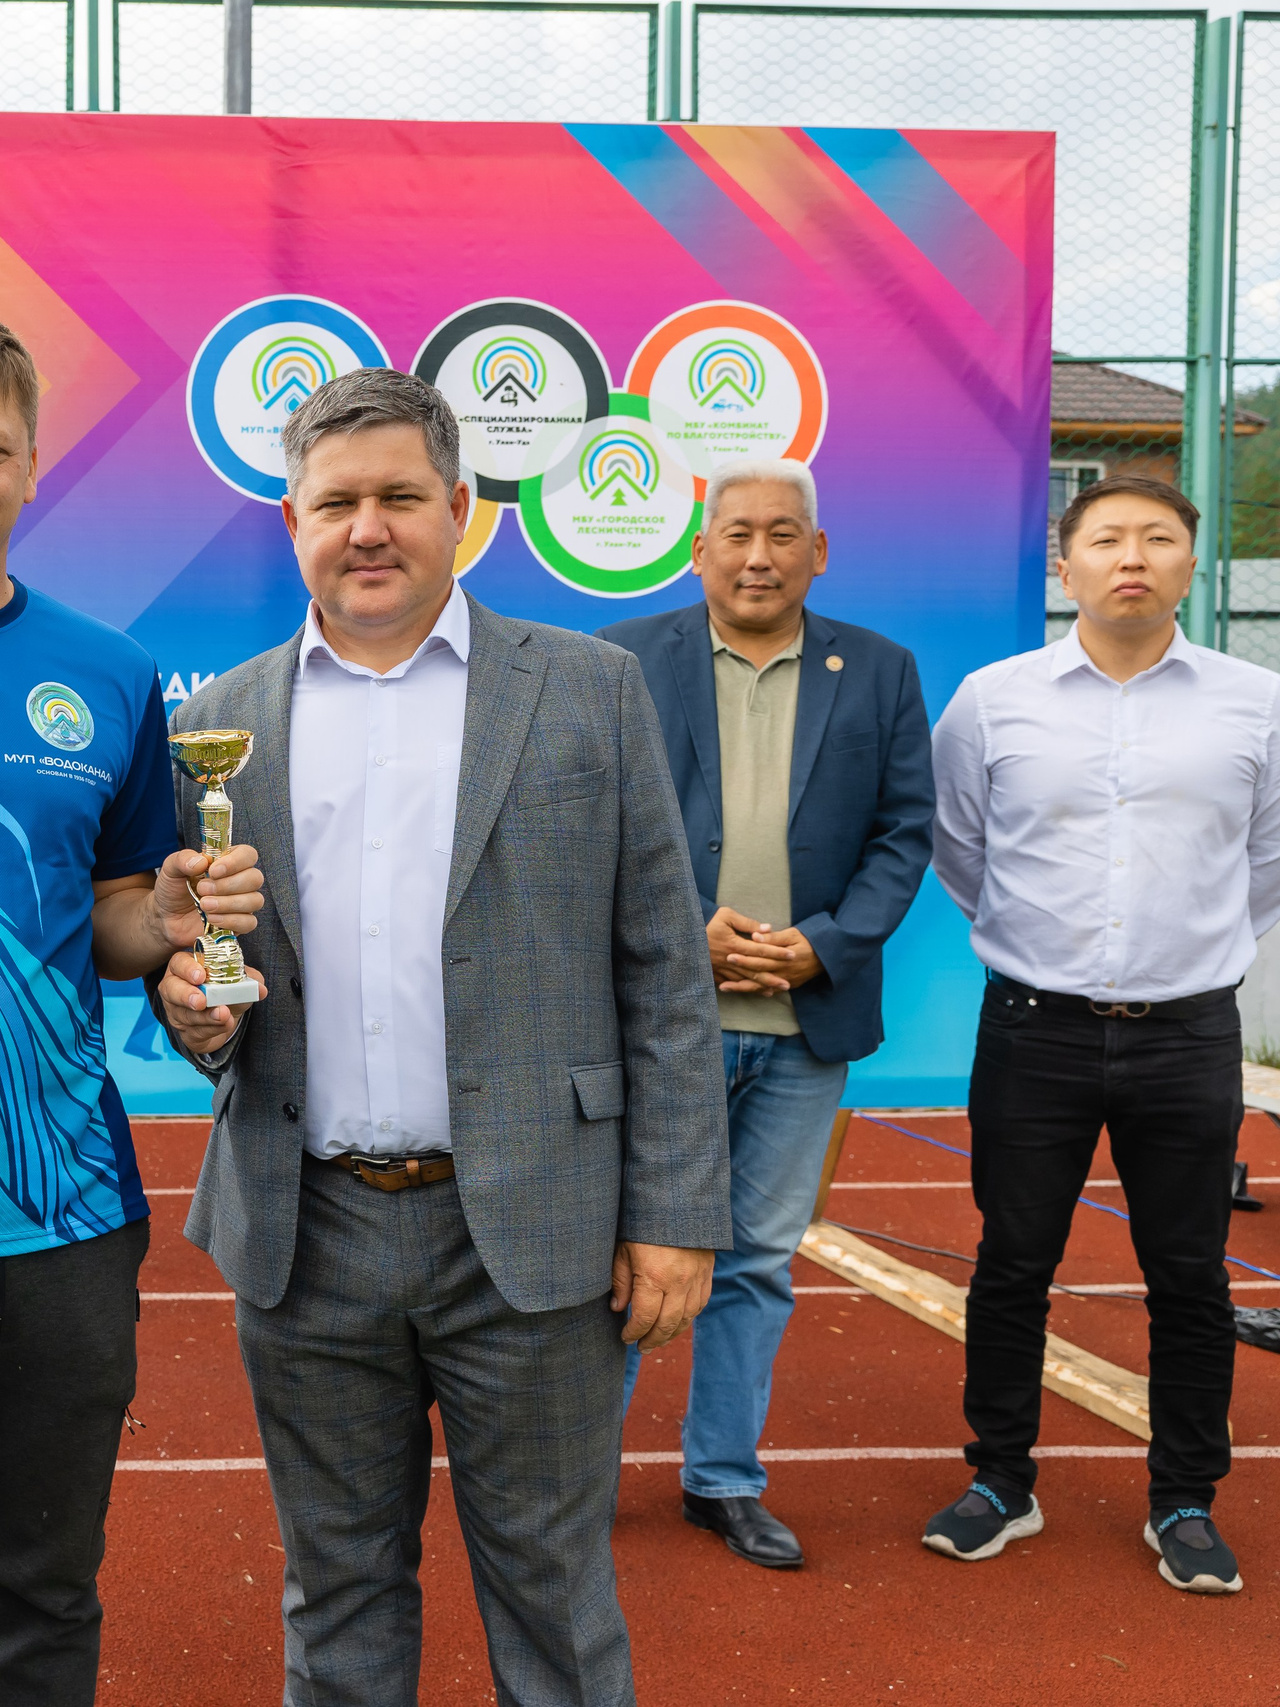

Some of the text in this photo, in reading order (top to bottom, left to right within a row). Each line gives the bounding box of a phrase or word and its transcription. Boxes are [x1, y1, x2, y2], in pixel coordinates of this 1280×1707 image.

[241, 426, 264, 434] МУП
[486, 426, 533, 434] СЛУЖБА»
[684, 421, 769, 430] МБУ «КОМБИНАТ
[666, 432, 681, 440] ПО
[572, 515, 666, 524] МБУ «ГОРОДСКОЕ
[4, 753, 113, 783] МУП «ВОДОКАНАЛ»
[36, 768, 68, 779] ОСНОВАН
